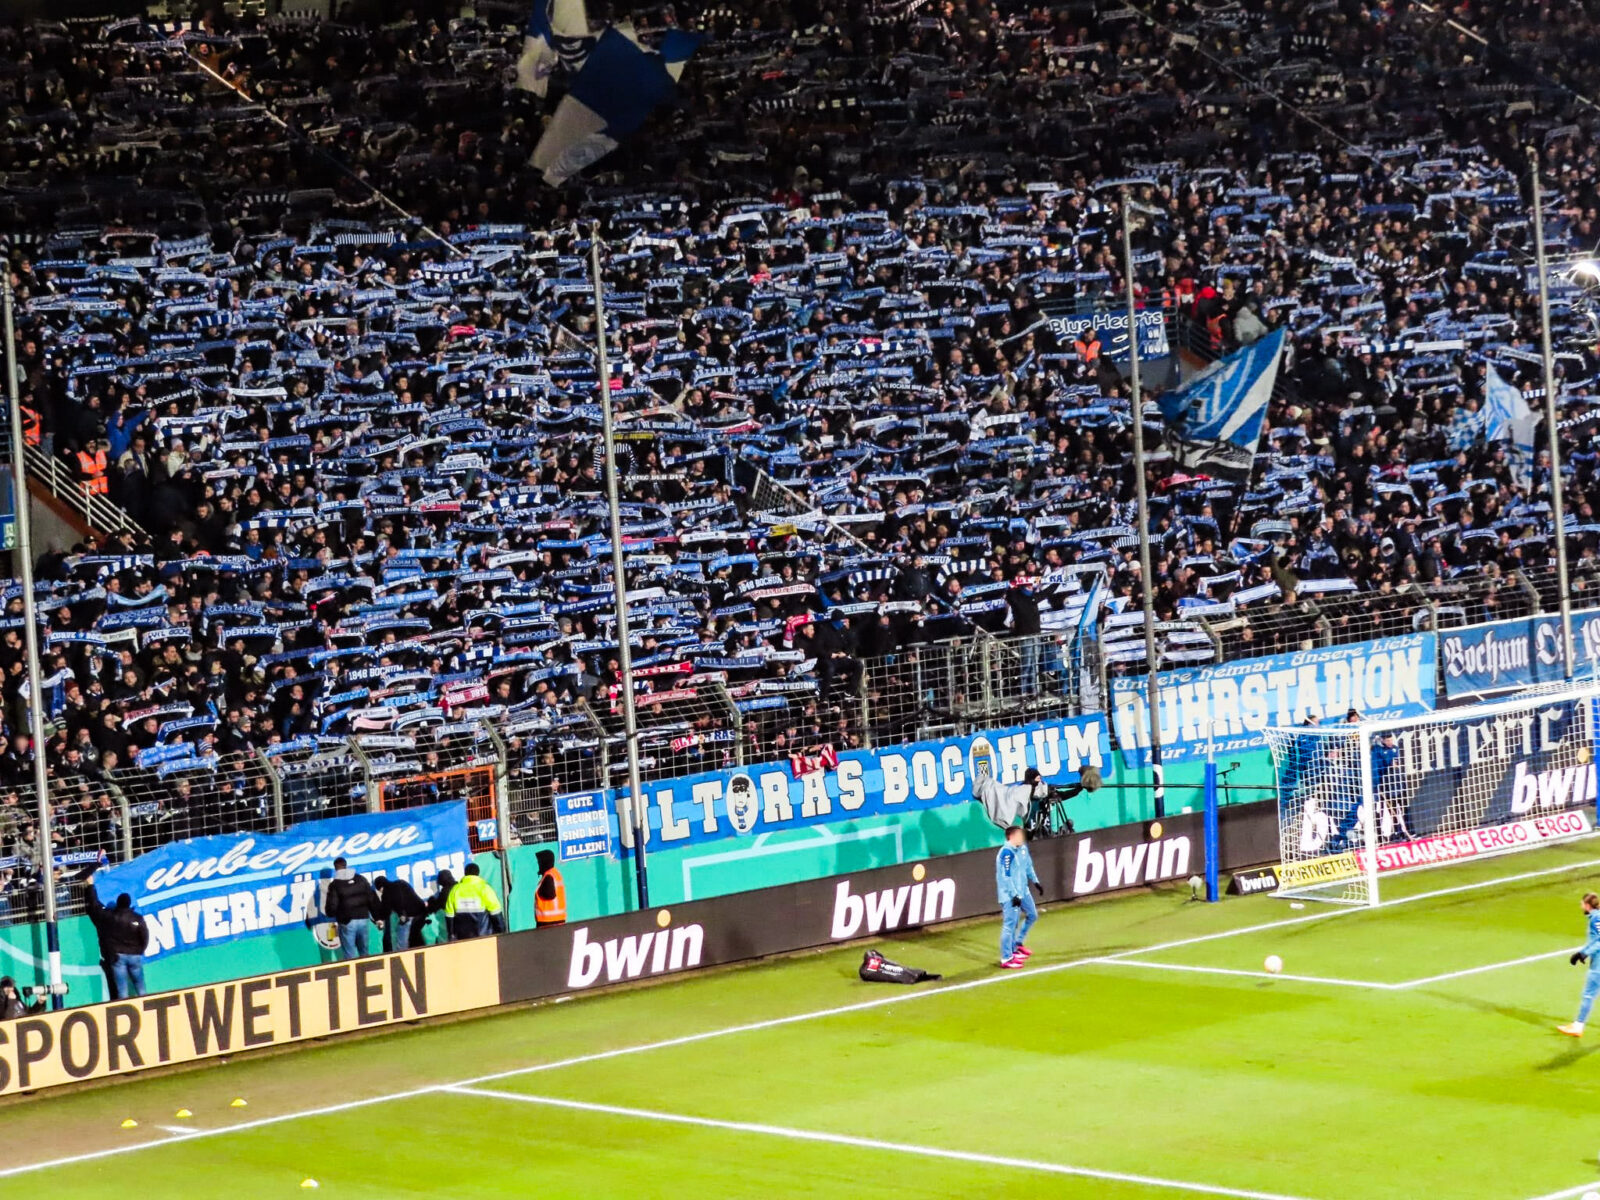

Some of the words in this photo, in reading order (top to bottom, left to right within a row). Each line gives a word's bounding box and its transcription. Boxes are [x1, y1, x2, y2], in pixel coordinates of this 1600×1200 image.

[1050, 317, 1092, 335] Blue
[1093, 311, 1164, 331] Hearts
[1369, 634, 1424, 654] Liebe
[1443, 630, 1530, 683] Bochum
[349, 667, 368, 681] 1848
[369, 664, 404, 678] BOCHUM
[1114, 647, 1422, 750] RUHRSTADION
[567, 796, 594, 810] GUTE
[559, 809, 606, 825] FREUNDE
[1536, 813, 1584, 839] ERGO
[479, 821, 497, 839] 22
[563, 828, 587, 841] SIND
[588, 825, 606, 837] NIE
[1478, 824, 1528, 849] ERGO
[61, 851, 98, 862] BOCHUM
[145, 824, 421, 891] unbequem
[566, 840, 606, 857] ALLEIN!
[1074, 822, 1191, 894] bwin
[1278, 856, 1358, 883] SPORTWETTEN
[1239, 872, 1276, 892] bwin
[830, 863, 957, 939] bwin
[568, 908, 704, 989] bwin
